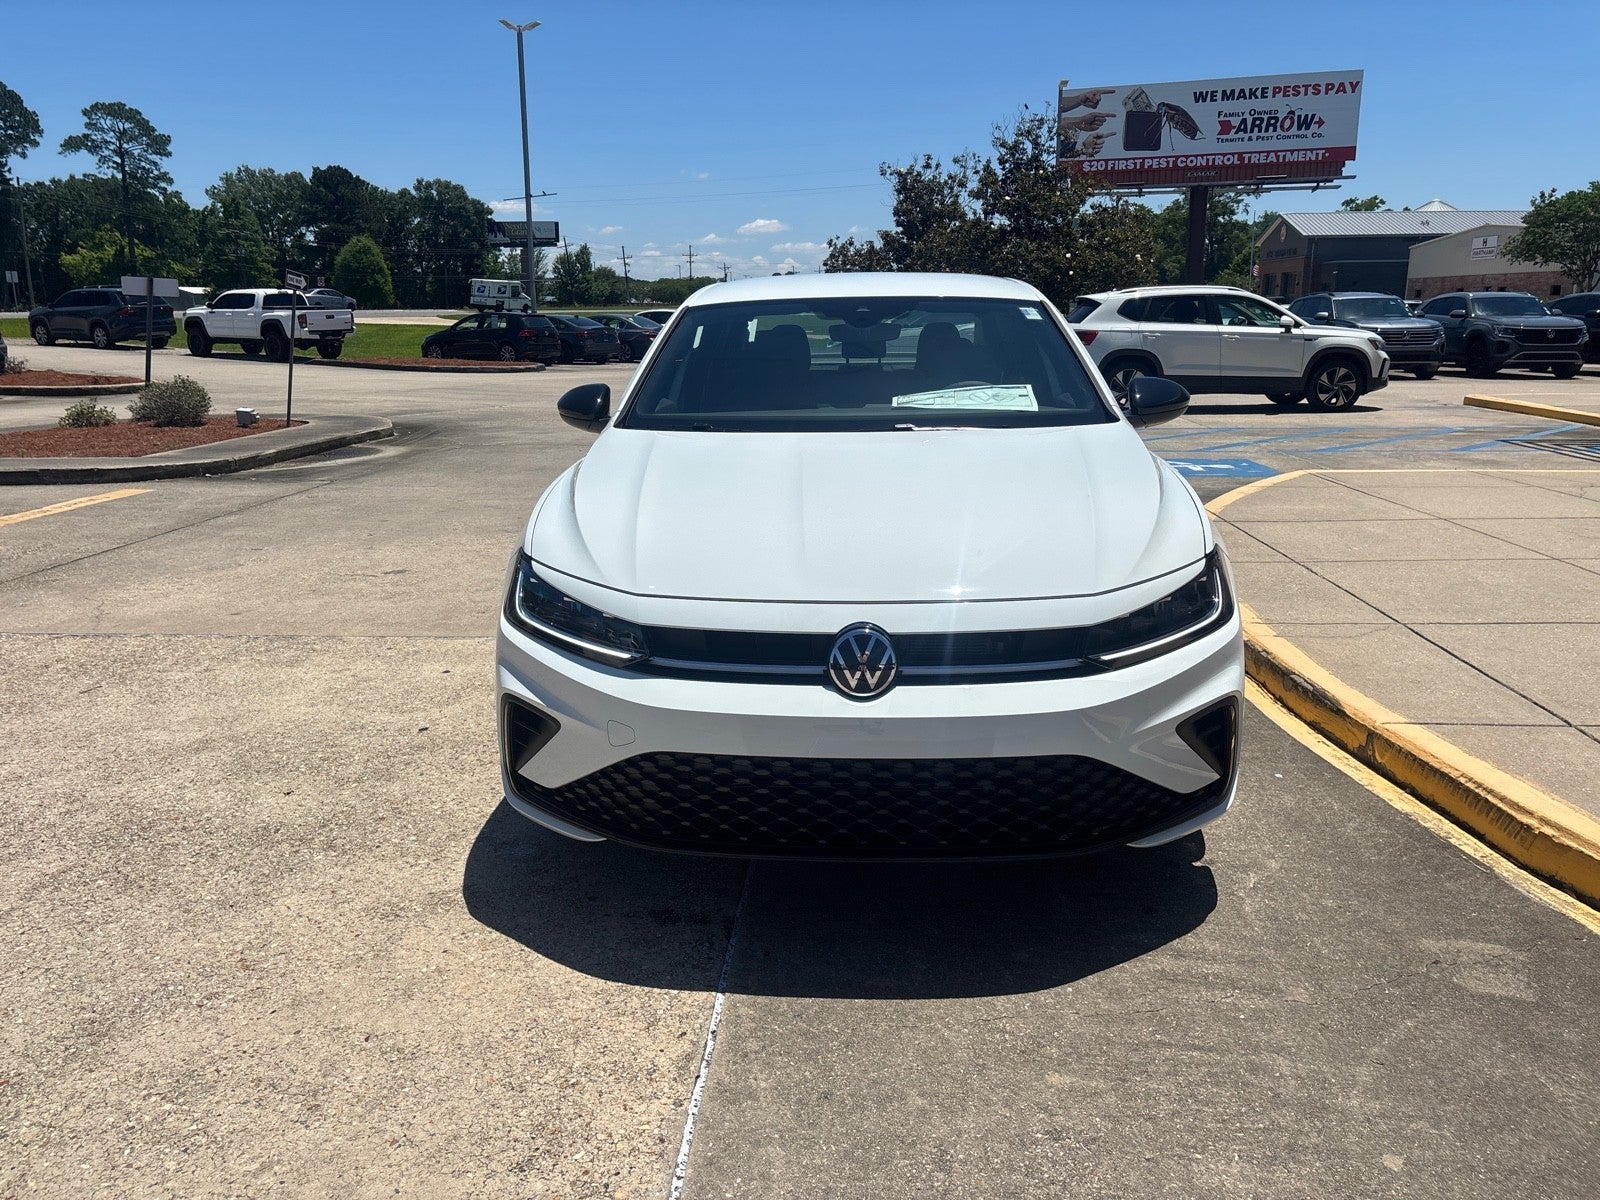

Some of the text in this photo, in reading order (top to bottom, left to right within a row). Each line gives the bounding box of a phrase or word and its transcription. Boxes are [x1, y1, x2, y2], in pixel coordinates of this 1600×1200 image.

[1193, 81, 1360, 103] WE MAKE PESTS PAY
[1234, 113, 1316, 135] ARROW
[1082, 161, 1105, 173] $20
[1107, 159, 1142, 170] FIRST
[1144, 157, 1176, 169] PEST
[1177, 154, 1241, 167] CONTROL
